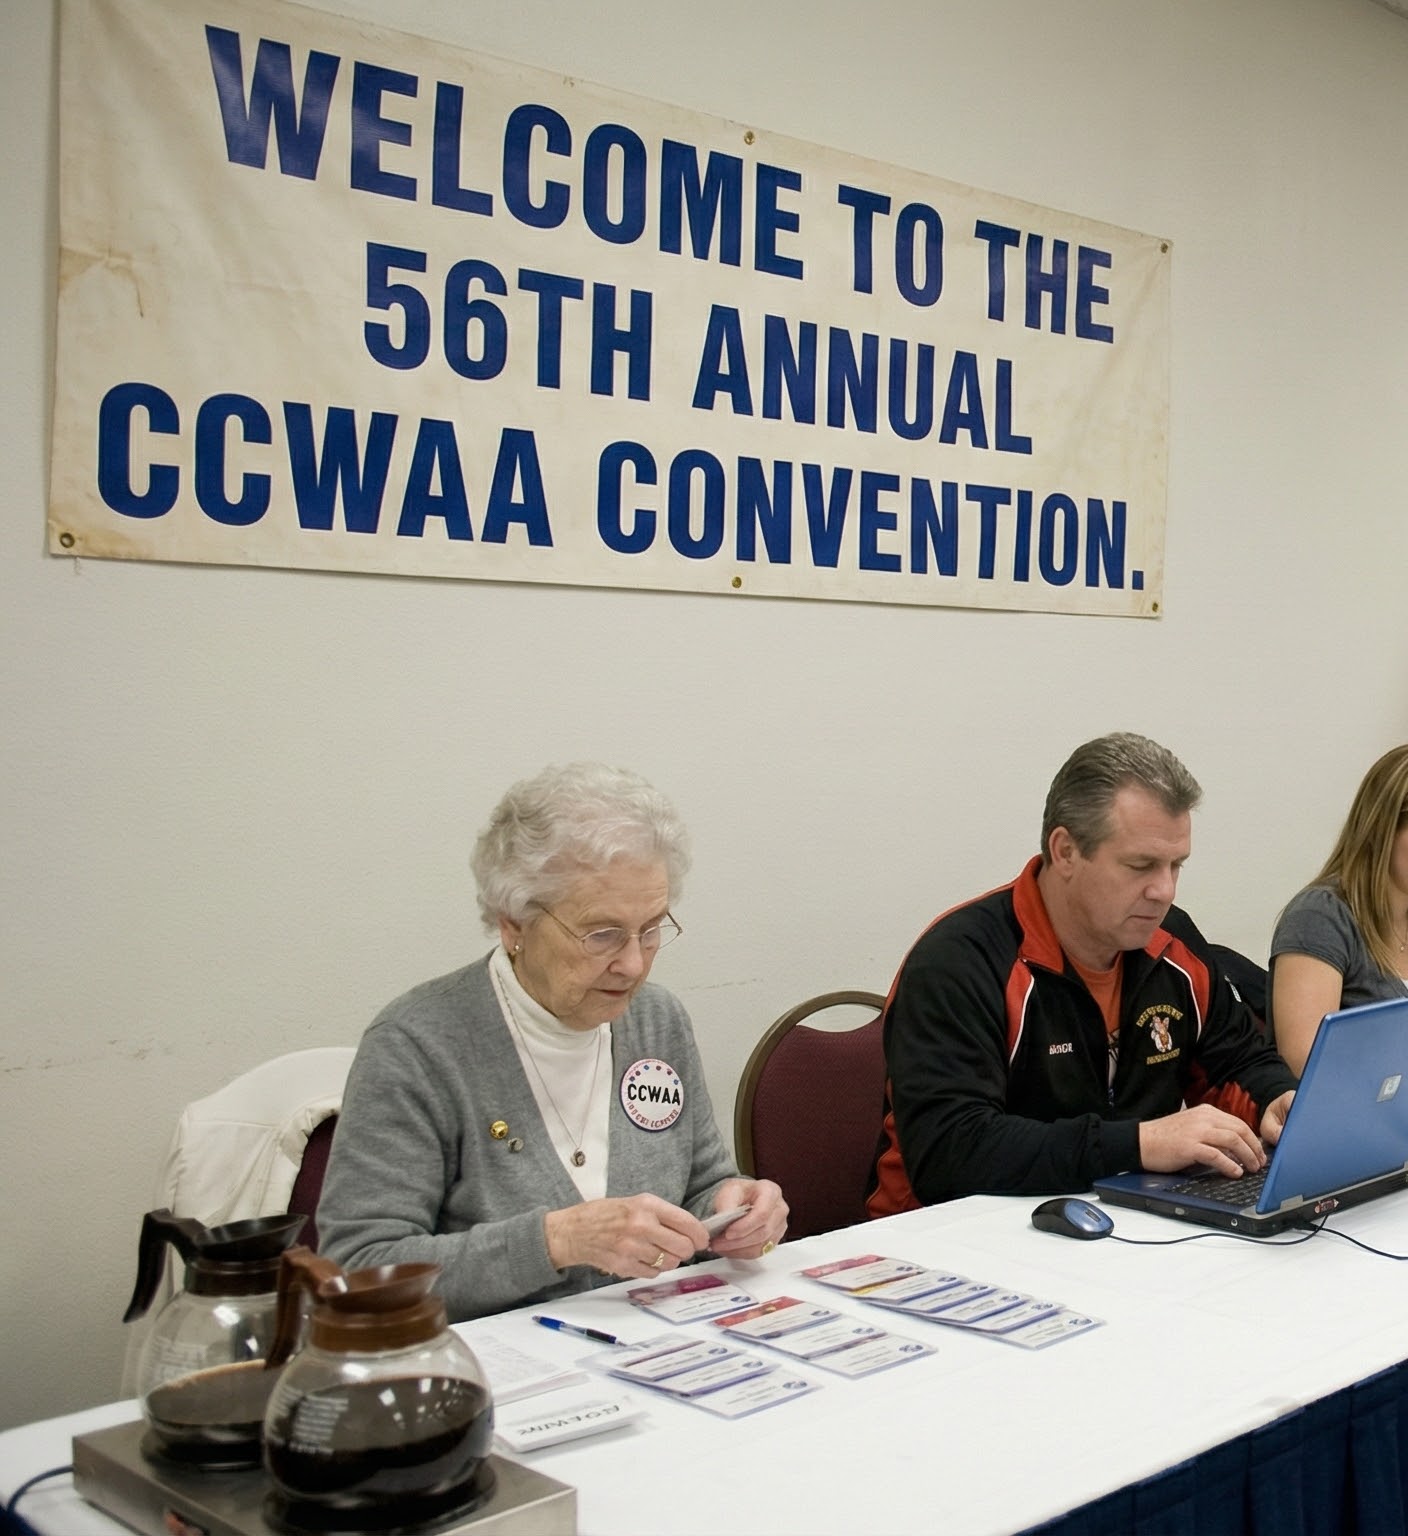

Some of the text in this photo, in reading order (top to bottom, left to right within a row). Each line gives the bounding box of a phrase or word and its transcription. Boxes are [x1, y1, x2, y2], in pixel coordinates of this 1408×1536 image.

[205, 24, 1114, 344] WELCOME TO THE
[363, 241, 1033, 456] 56TH ANNUAL
[97, 382, 1144, 591] CCWAA CONVENTION.
[627, 1083, 681, 1106] CCWAA
